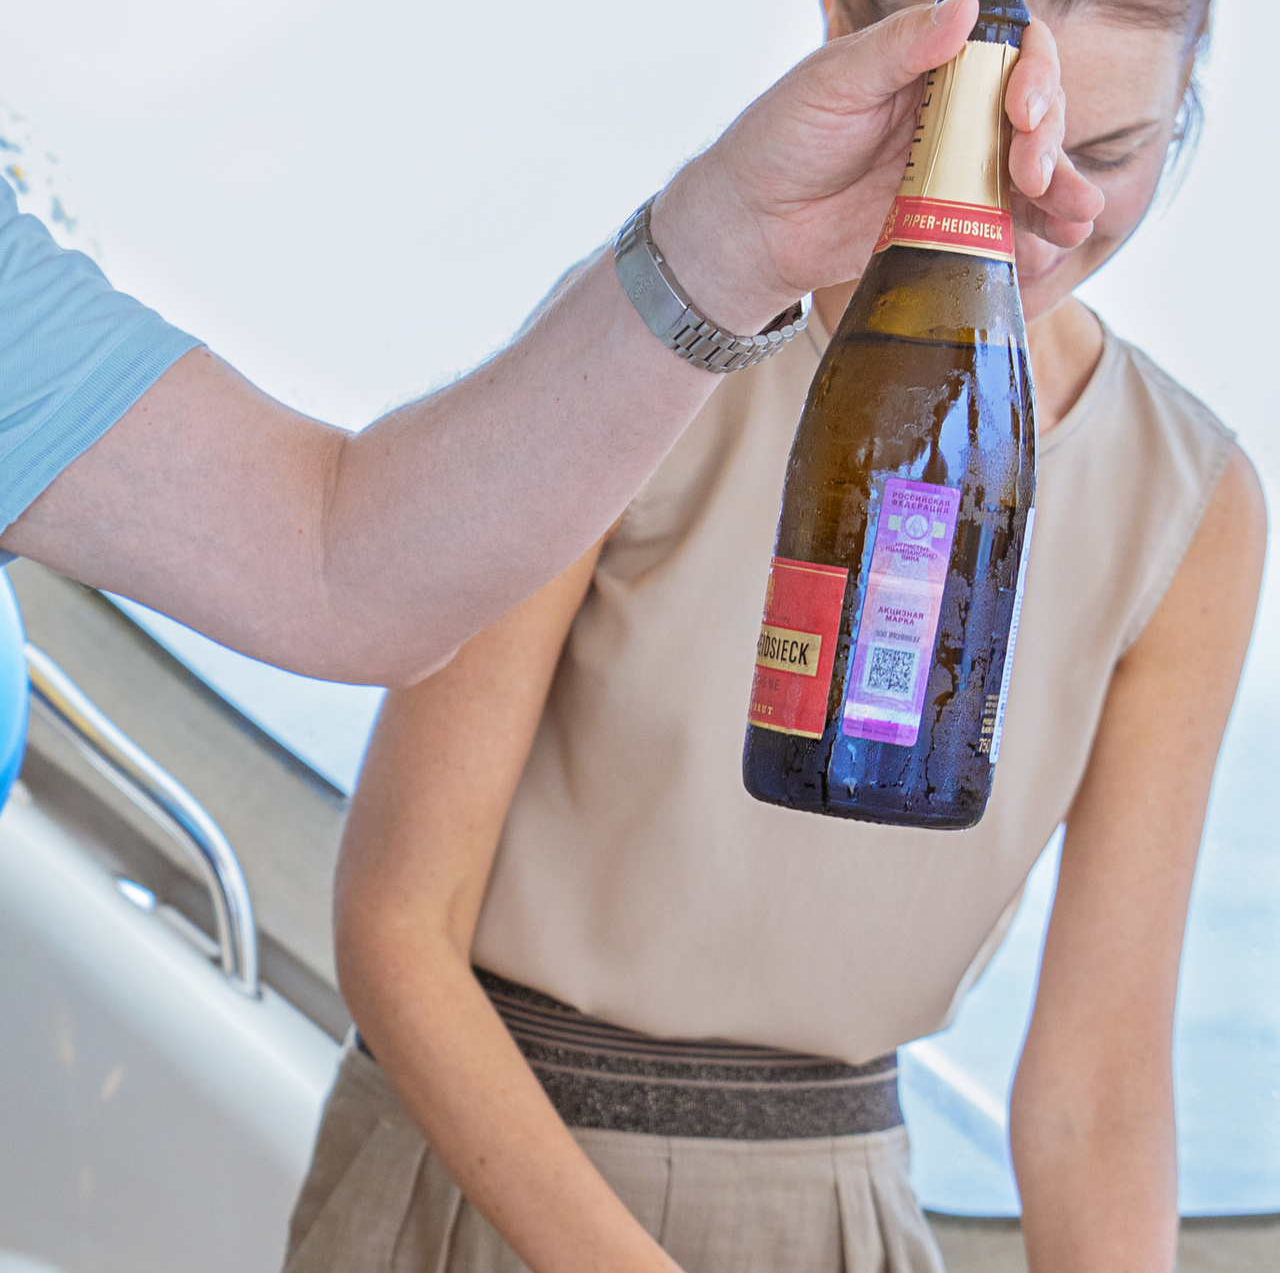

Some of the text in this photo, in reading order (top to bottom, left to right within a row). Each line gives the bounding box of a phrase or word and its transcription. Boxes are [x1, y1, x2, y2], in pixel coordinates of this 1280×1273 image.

[902, 213, 1003, 241] PIPER-HEIDSIECK
[891, 499, 949, 514] ФЕДЕРАЦИЯ
[892, 491, 951, 507] РОССИЙСКАЯ
[878, 606, 924, 620] АКЦИЗНАЯ
[885, 614, 915, 626] МАРКА
